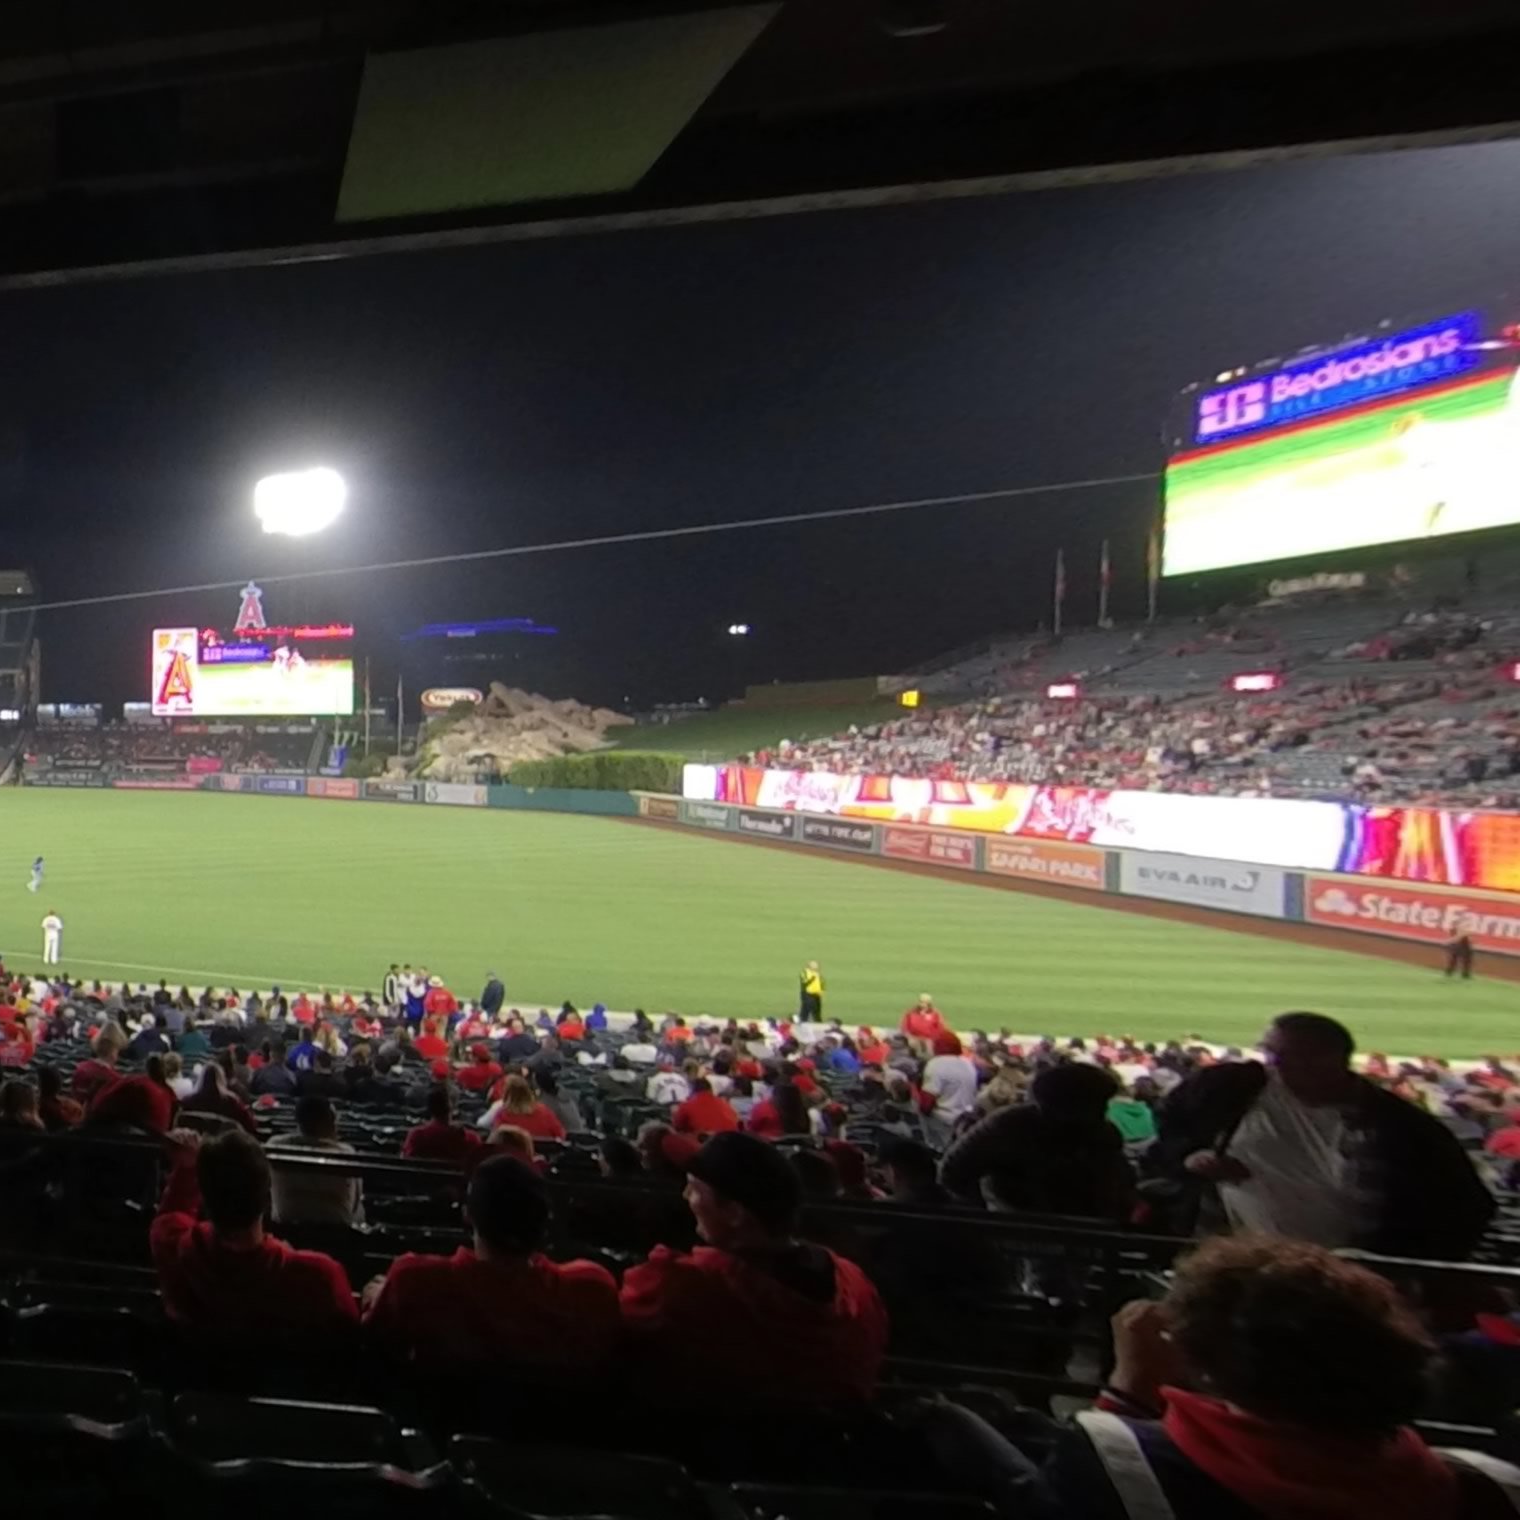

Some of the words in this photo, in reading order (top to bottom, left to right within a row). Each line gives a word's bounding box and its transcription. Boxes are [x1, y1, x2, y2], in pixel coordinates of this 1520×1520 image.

[1271, 328, 1462, 403] Bedrosians
[991, 852, 1046, 873] SAFARI
[1049, 860, 1098, 881] PARK
[1137, 866, 1181, 883] EVA
[1184, 872, 1228, 889] AIR
[1359, 893, 1439, 928] State
